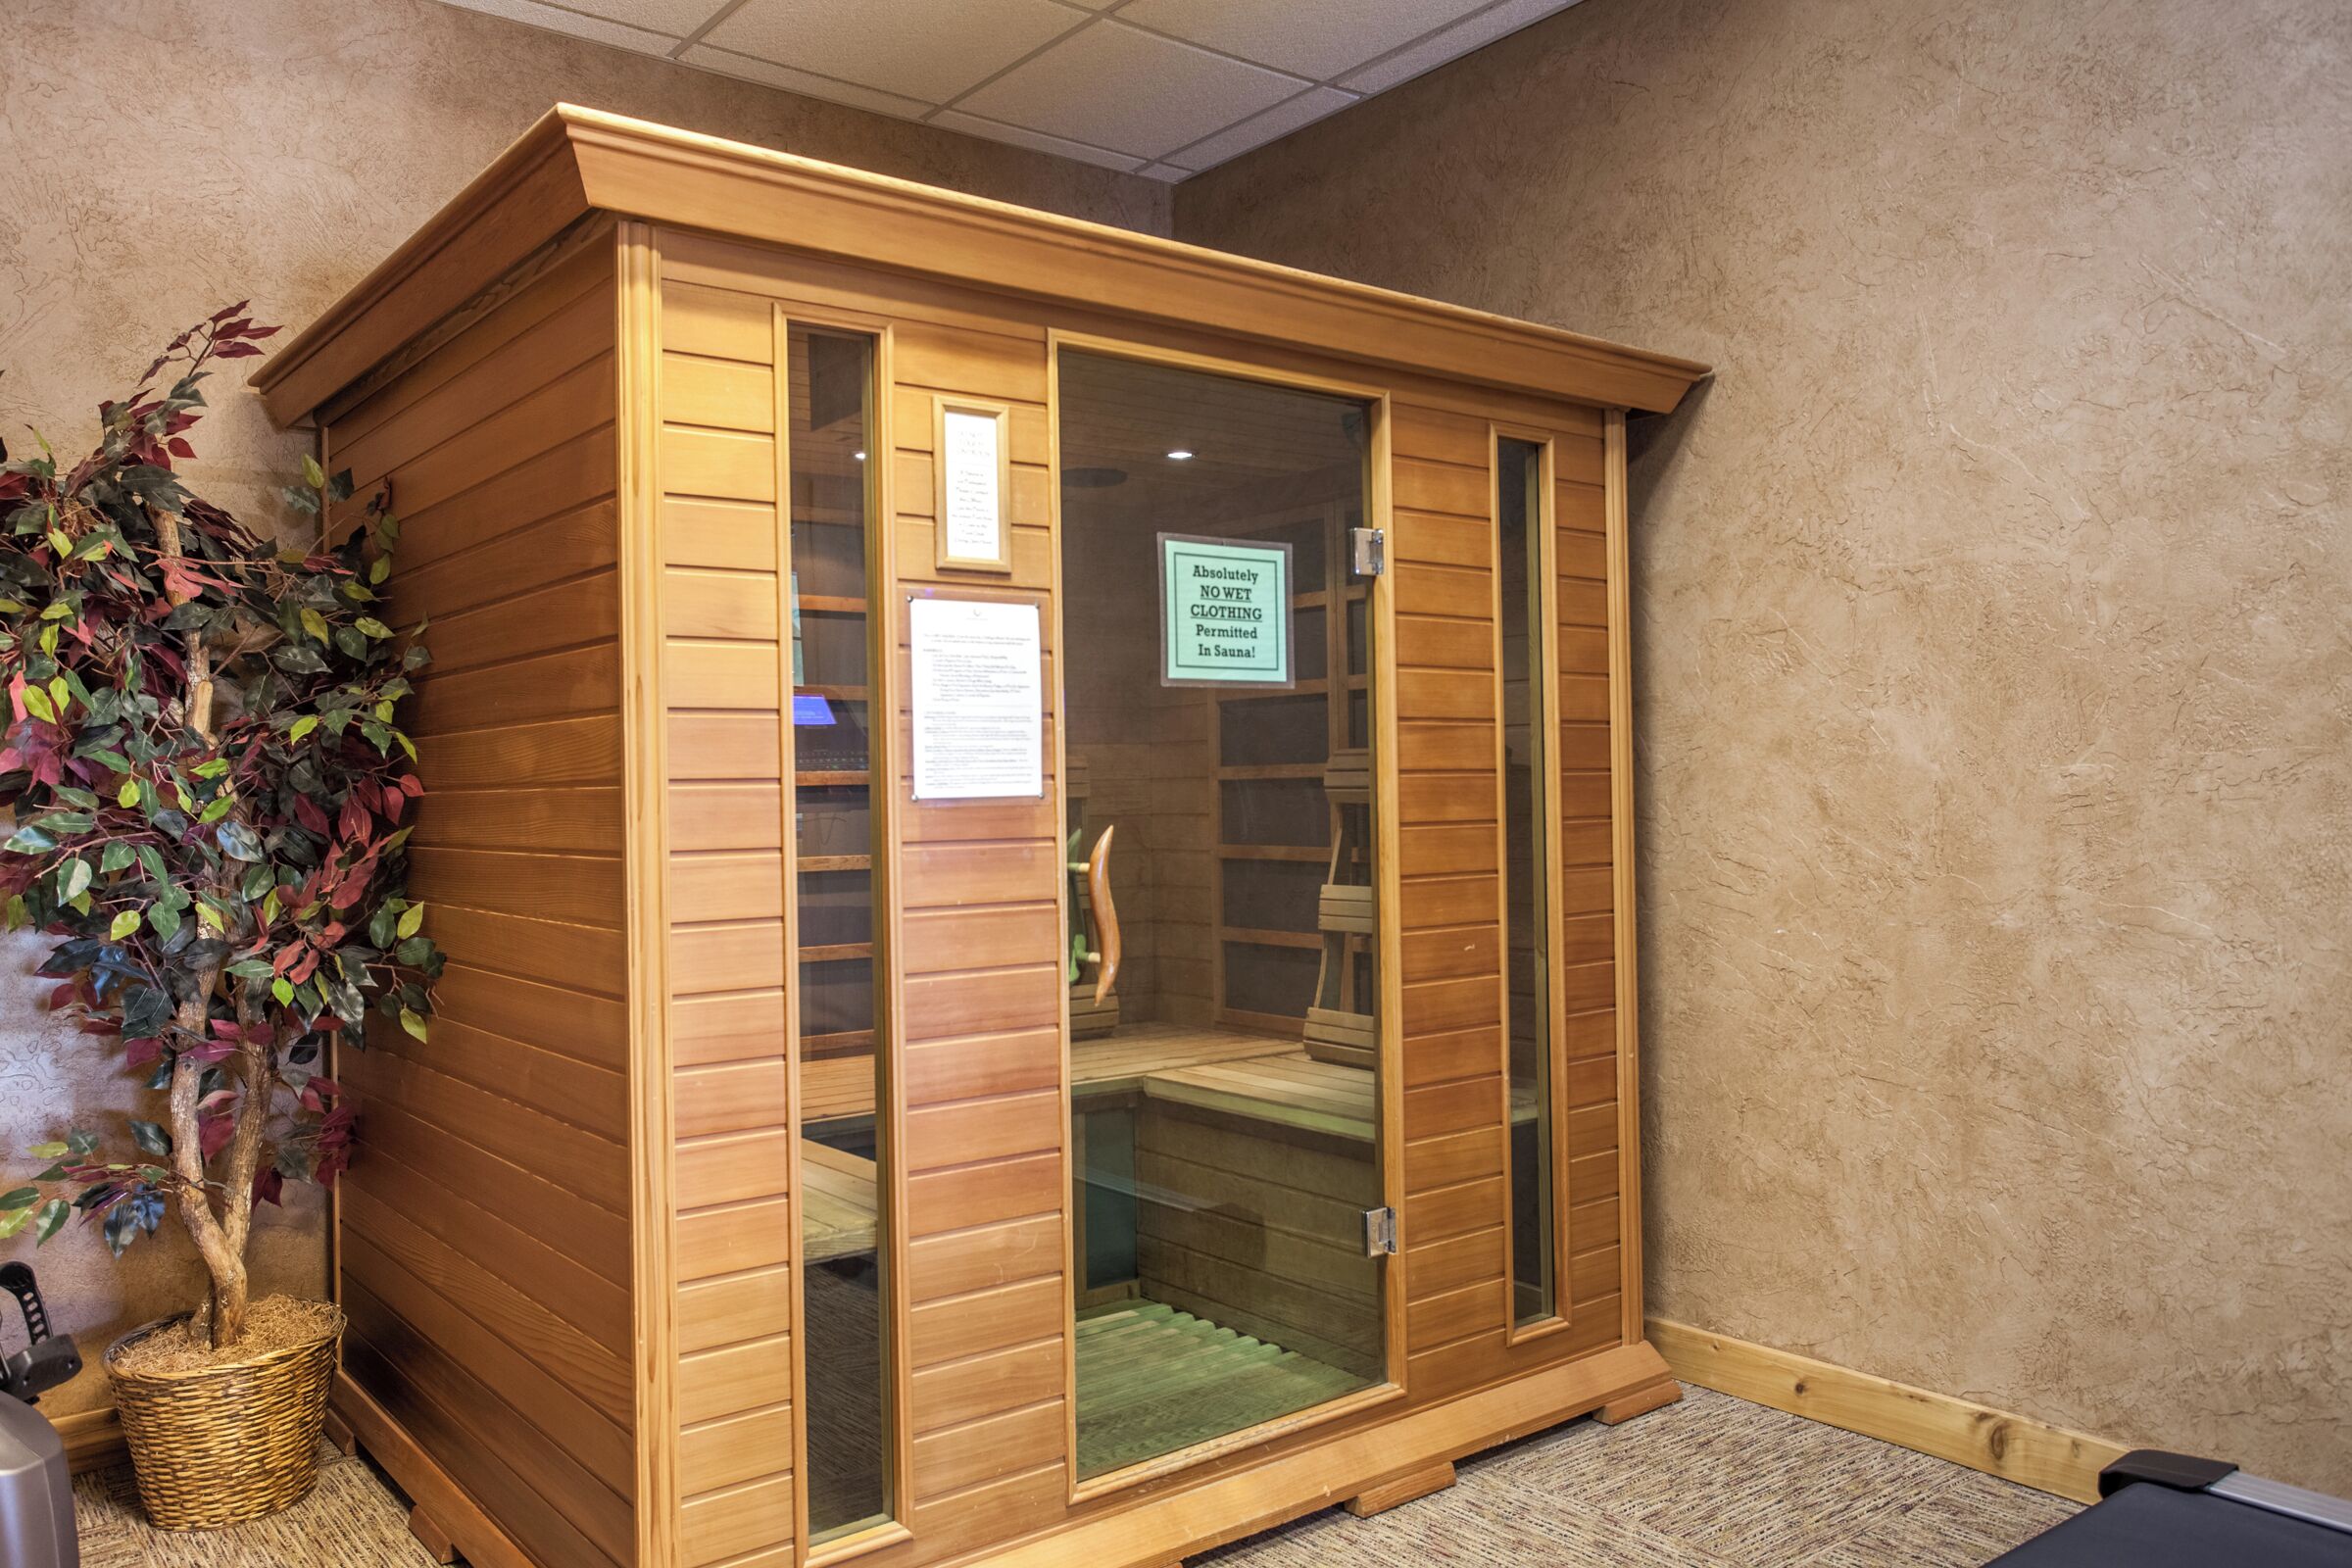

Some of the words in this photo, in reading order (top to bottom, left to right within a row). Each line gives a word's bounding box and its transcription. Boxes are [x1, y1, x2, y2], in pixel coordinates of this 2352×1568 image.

[1193, 565, 1258, 585] Absolutely
[1200, 586, 1220, 598] NO
[1223, 588, 1252, 601] WET
[1191, 605, 1262, 620] CLOTHING
[1196, 624, 1257, 639] Permitted
[1199, 644, 1211, 657] In
[1214, 645, 1256, 659] Sauna!
